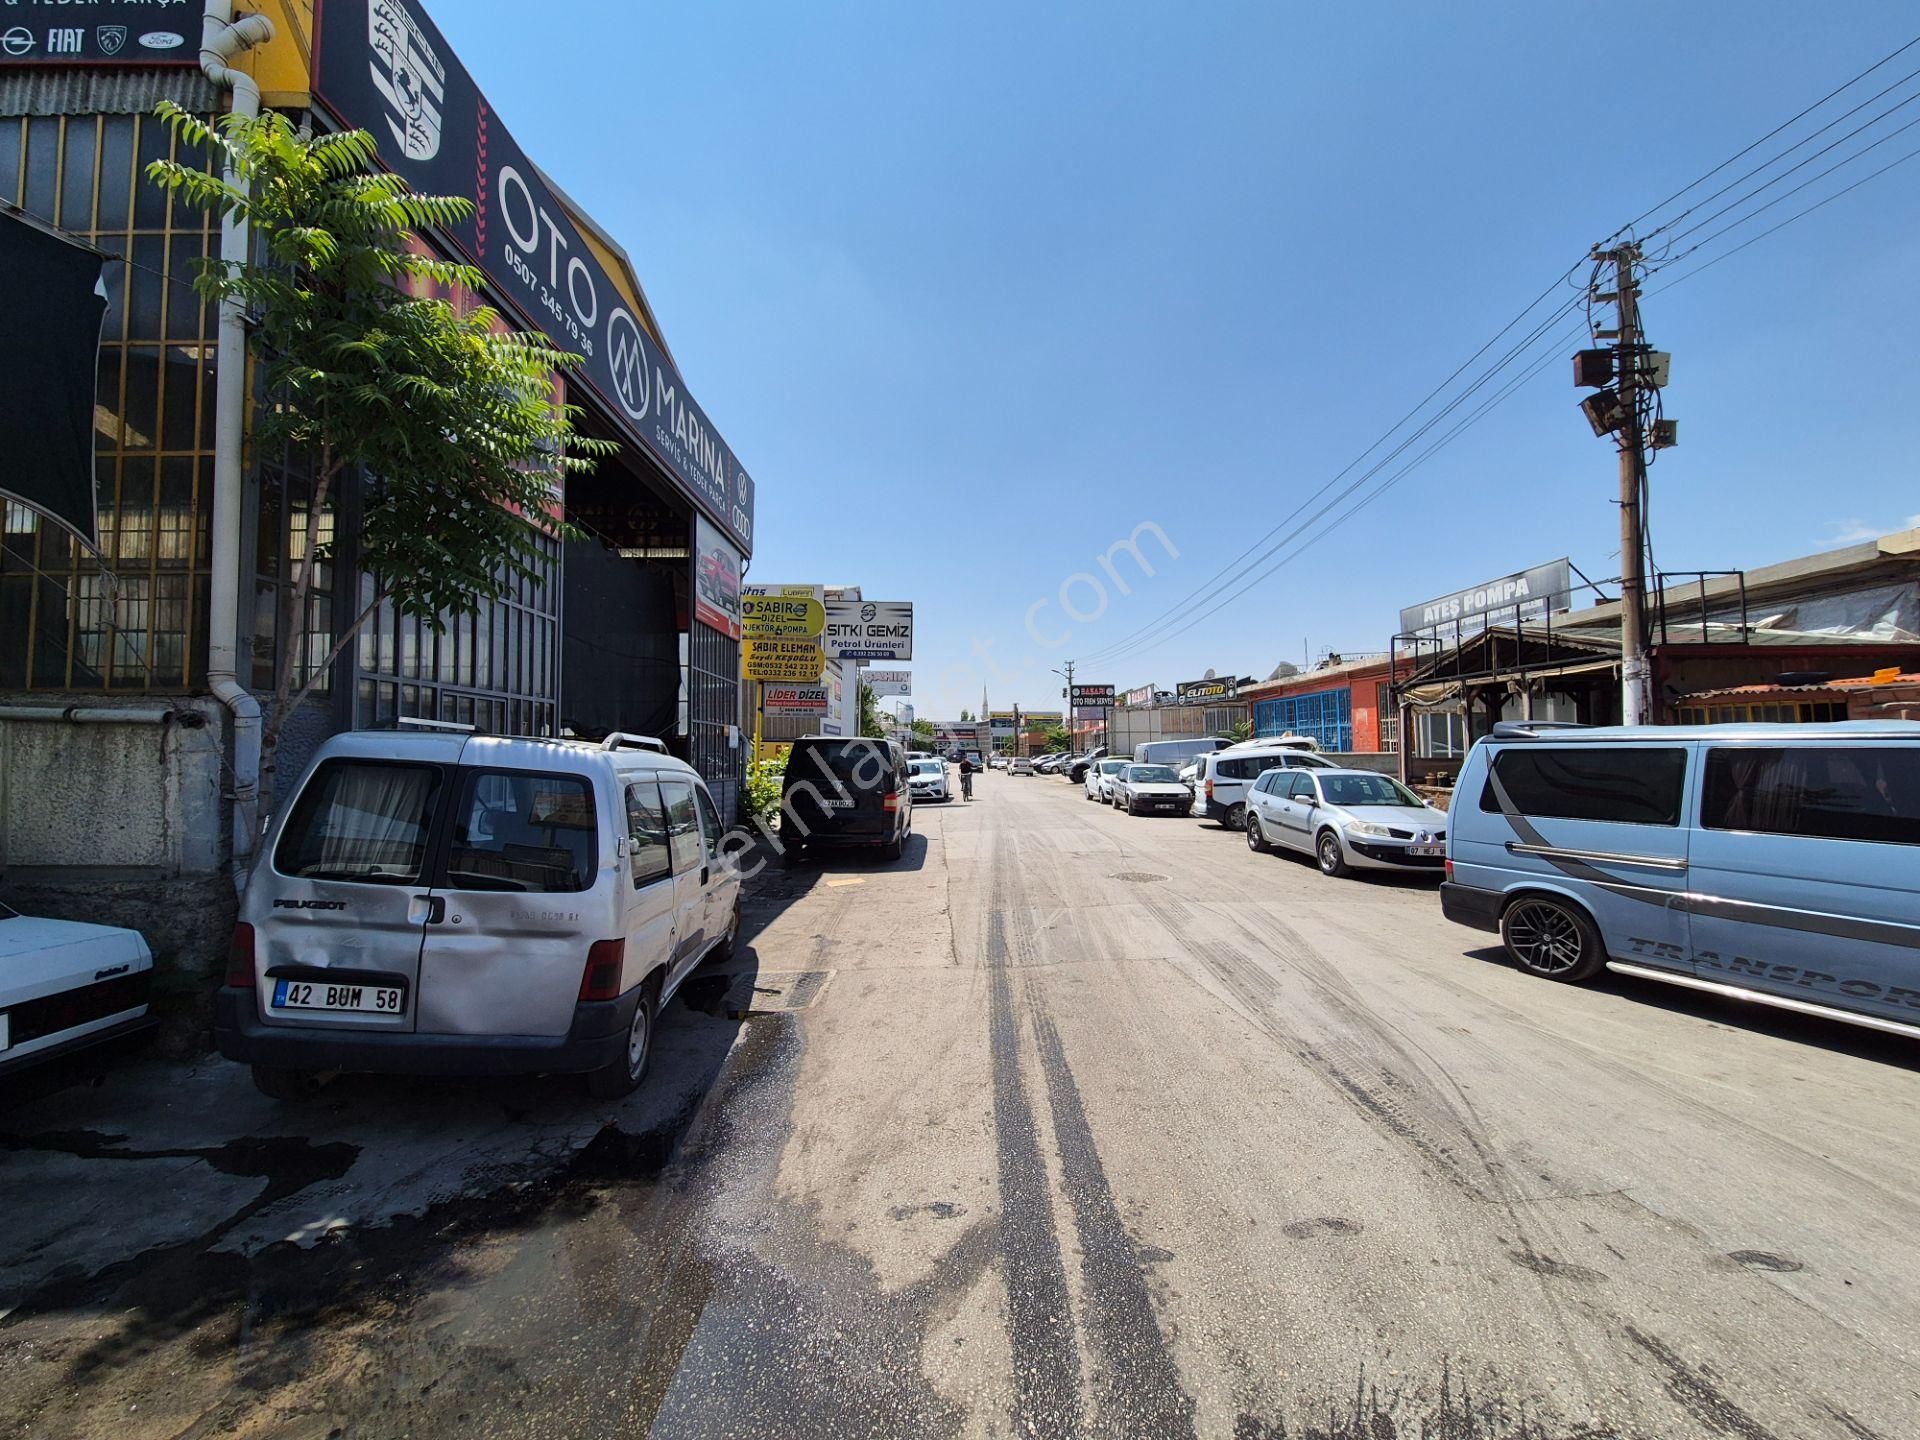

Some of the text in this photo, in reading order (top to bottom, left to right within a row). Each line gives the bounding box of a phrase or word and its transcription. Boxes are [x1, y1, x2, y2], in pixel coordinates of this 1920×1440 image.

[47, 28, 85, 53] FIAT
[504, 243, 594, 357] 0507 345 79 36
[498, 165, 597, 328] OTO
[656, 366, 725, 493] MARİNA
[656, 425, 726, 513] SERVİS & YEDEK PARÇA
[1423, 599, 1460, 623] ATEŞ
[1463, 577, 1530, 612] POMPA
[756, 601, 793, 614] SABIR
[761, 614, 787, 623] DİZEL
[742, 623, 807, 635] NJEKTÖR POMPA
[827, 622, 909, 637] SITKI GEMİZ
[752, 642, 816, 654] SABIR ELEMAN
[831, 639, 905, 648] Petrol Ürünleri
[768, 688, 797, 699] LİDER
[798, 689, 826, 699] DİZEL
[1072, 697, 1084, 705] OTO
[273, 899, 347, 910] PEUGEOT
[288, 985, 311, 1006] 42
[326, 986, 363, 1008] BUM
[376, 989, 398, 1010] 58
